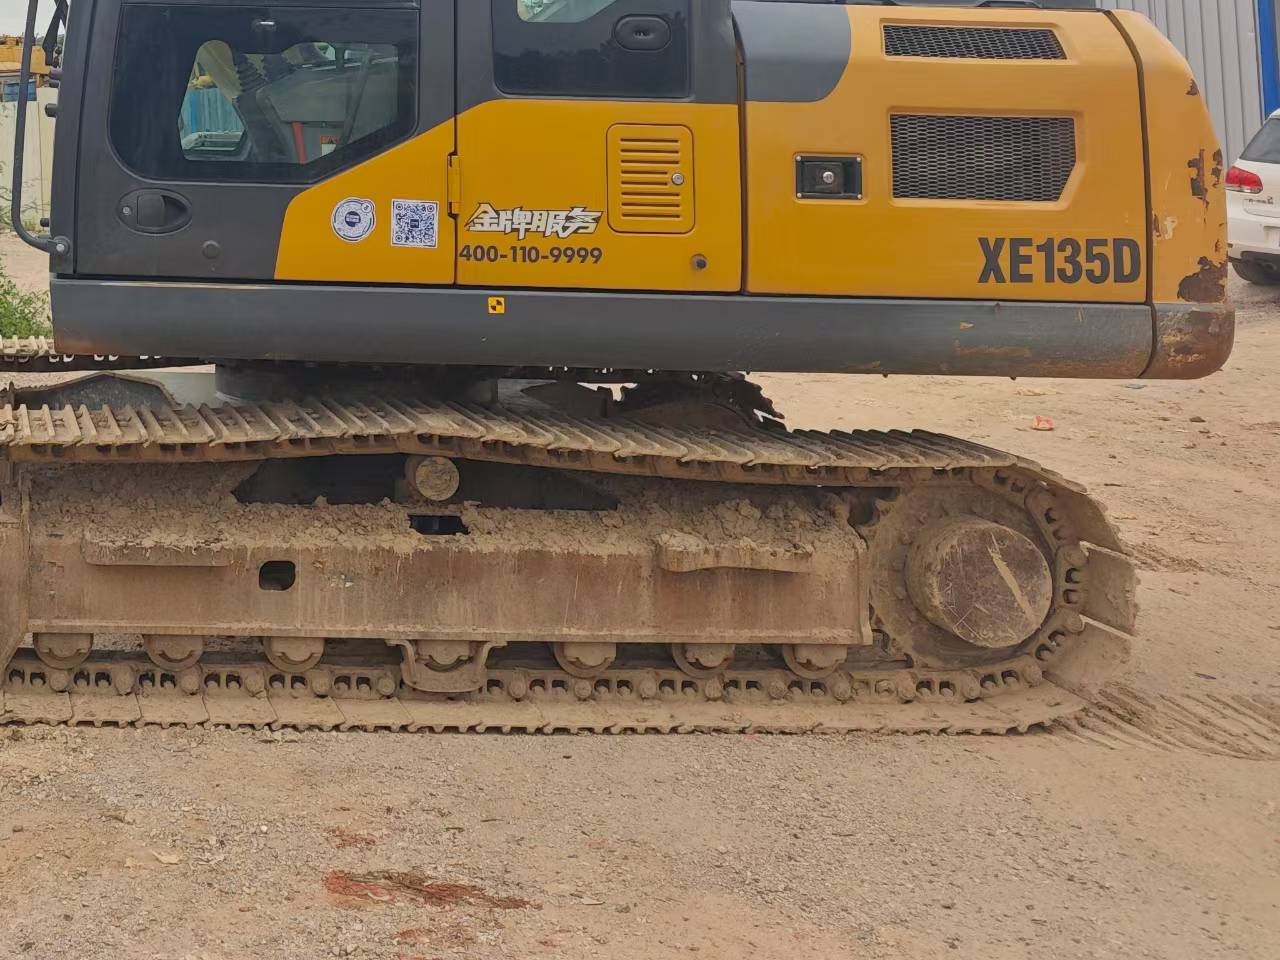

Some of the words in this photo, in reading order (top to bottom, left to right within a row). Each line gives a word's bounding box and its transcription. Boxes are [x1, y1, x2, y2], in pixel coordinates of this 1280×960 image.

[465, 202, 604, 240] 金牌服务
[459, 244, 602, 264] 400-110-9999
[978, 237, 1141, 284] XE135D
